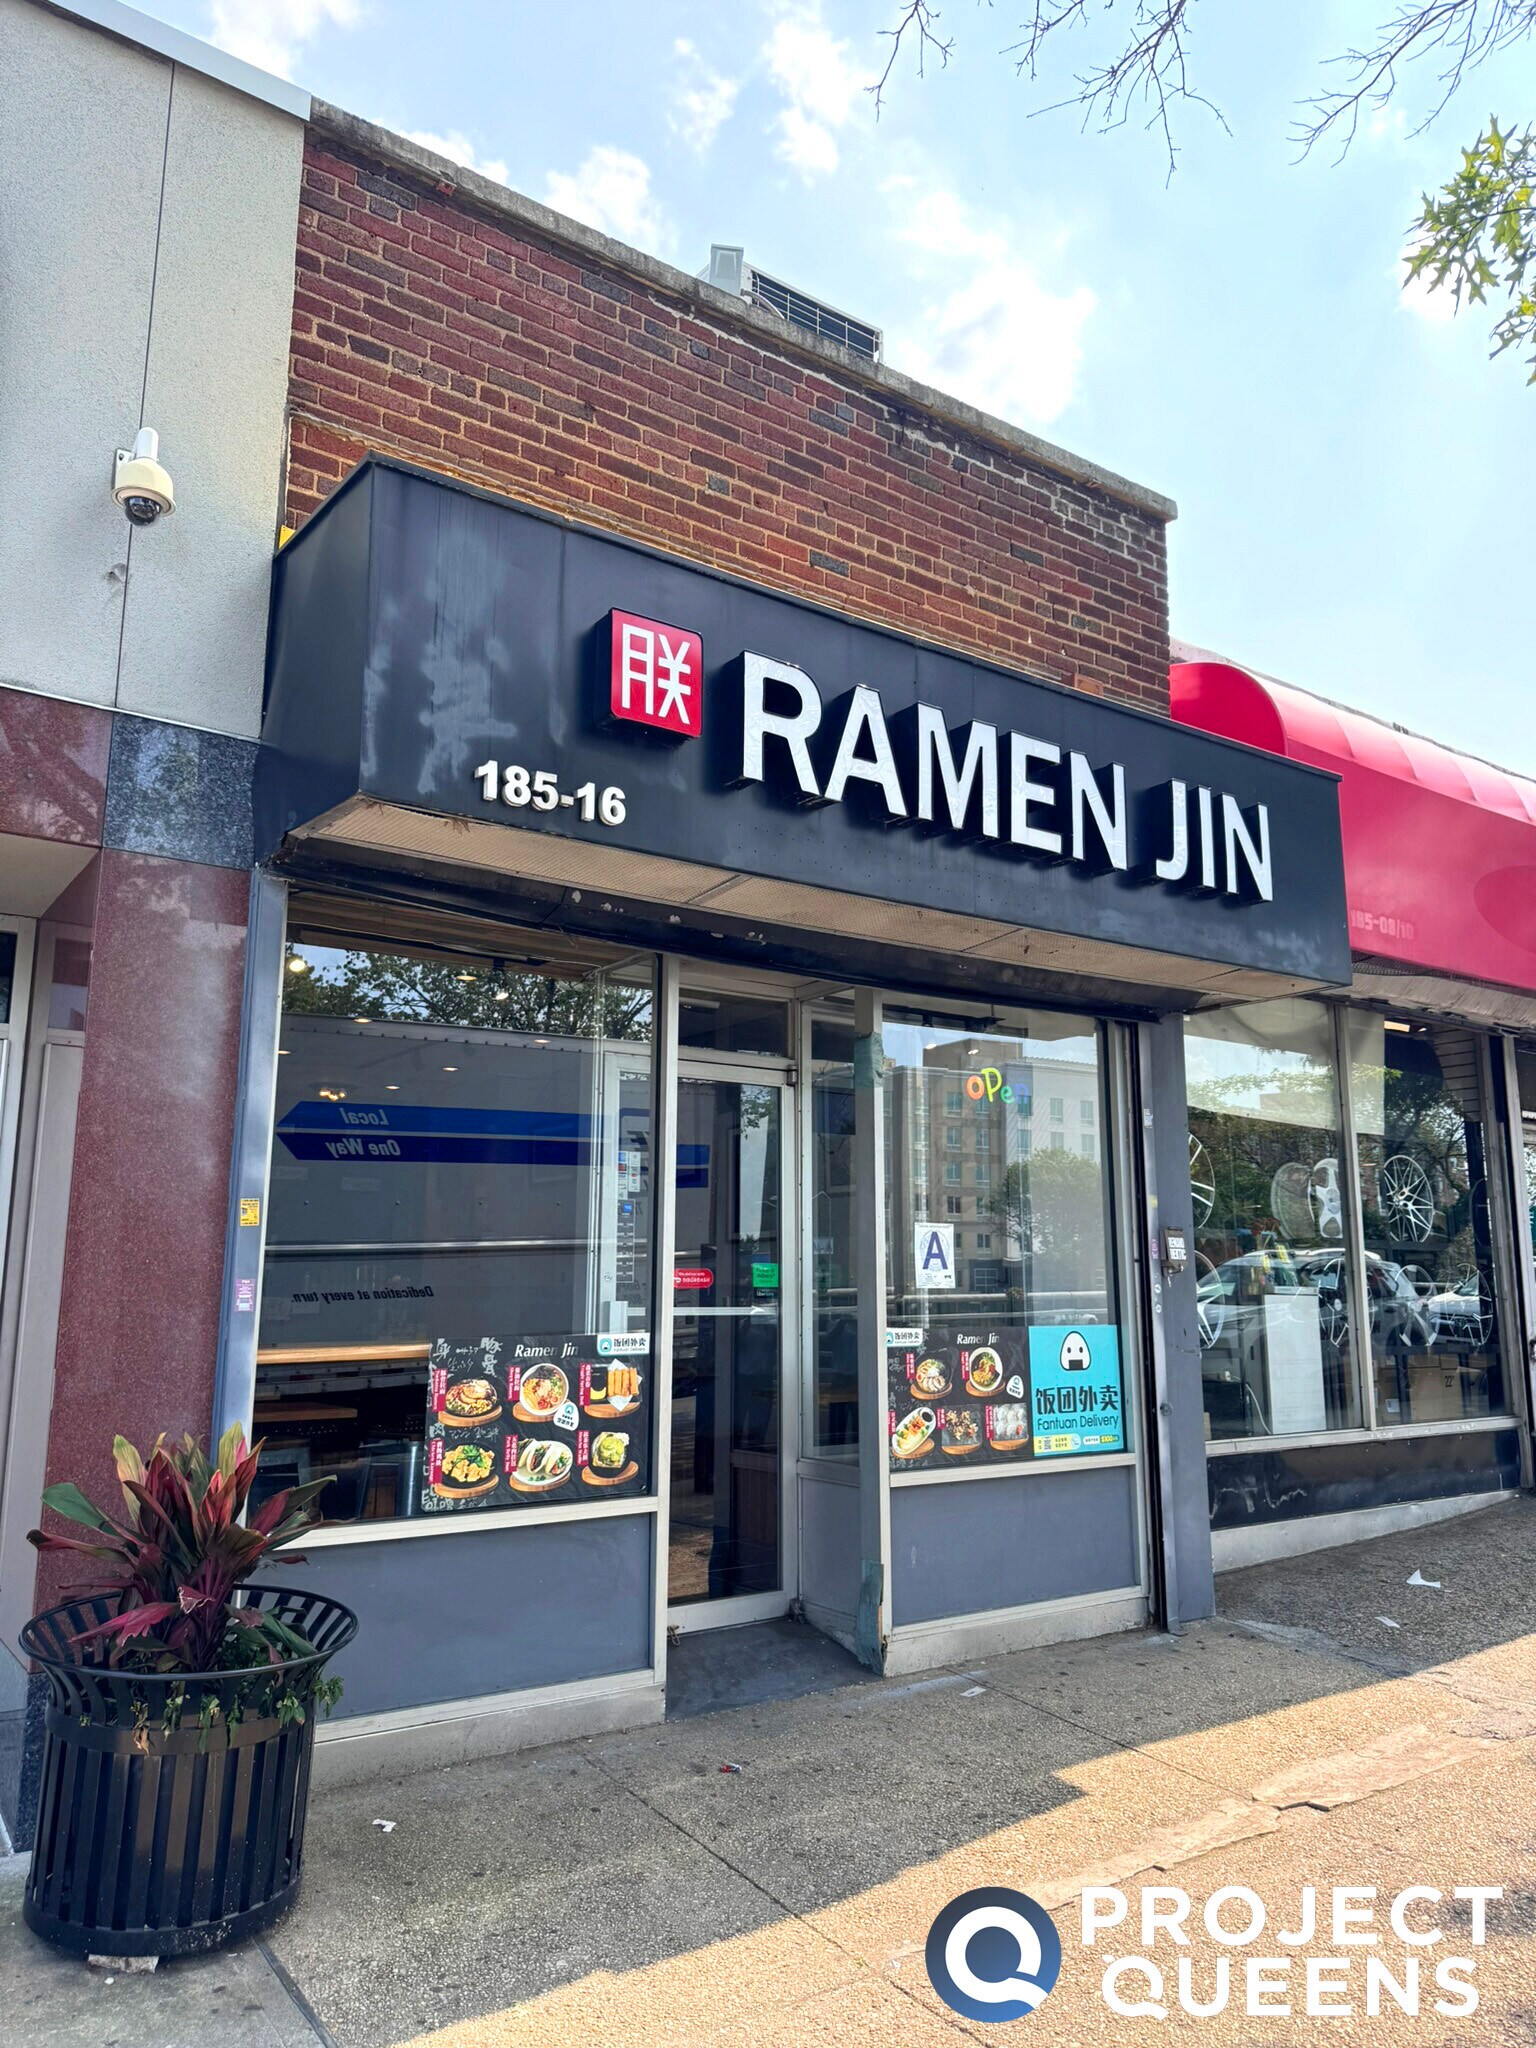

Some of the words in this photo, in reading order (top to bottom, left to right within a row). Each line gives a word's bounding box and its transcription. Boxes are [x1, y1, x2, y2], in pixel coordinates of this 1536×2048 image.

[740, 651, 1129, 872] RAMEN
[1154, 778, 1274, 905] JIN
[475, 760, 626, 827] 185-16
[922, 1231, 948, 1270] A
[514, 1344, 558, 1357] Ramen
[561, 1342, 579, 1358] Jin
[957, 1334, 984, 1344] Ramen
[988, 1333, 1000, 1345] Jin
[1035, 1385, 1119, 1415] 饭团外卖
[1037, 1417, 1077, 1431] Fantuan
[1080, 1414, 1119, 1429] Delivery
